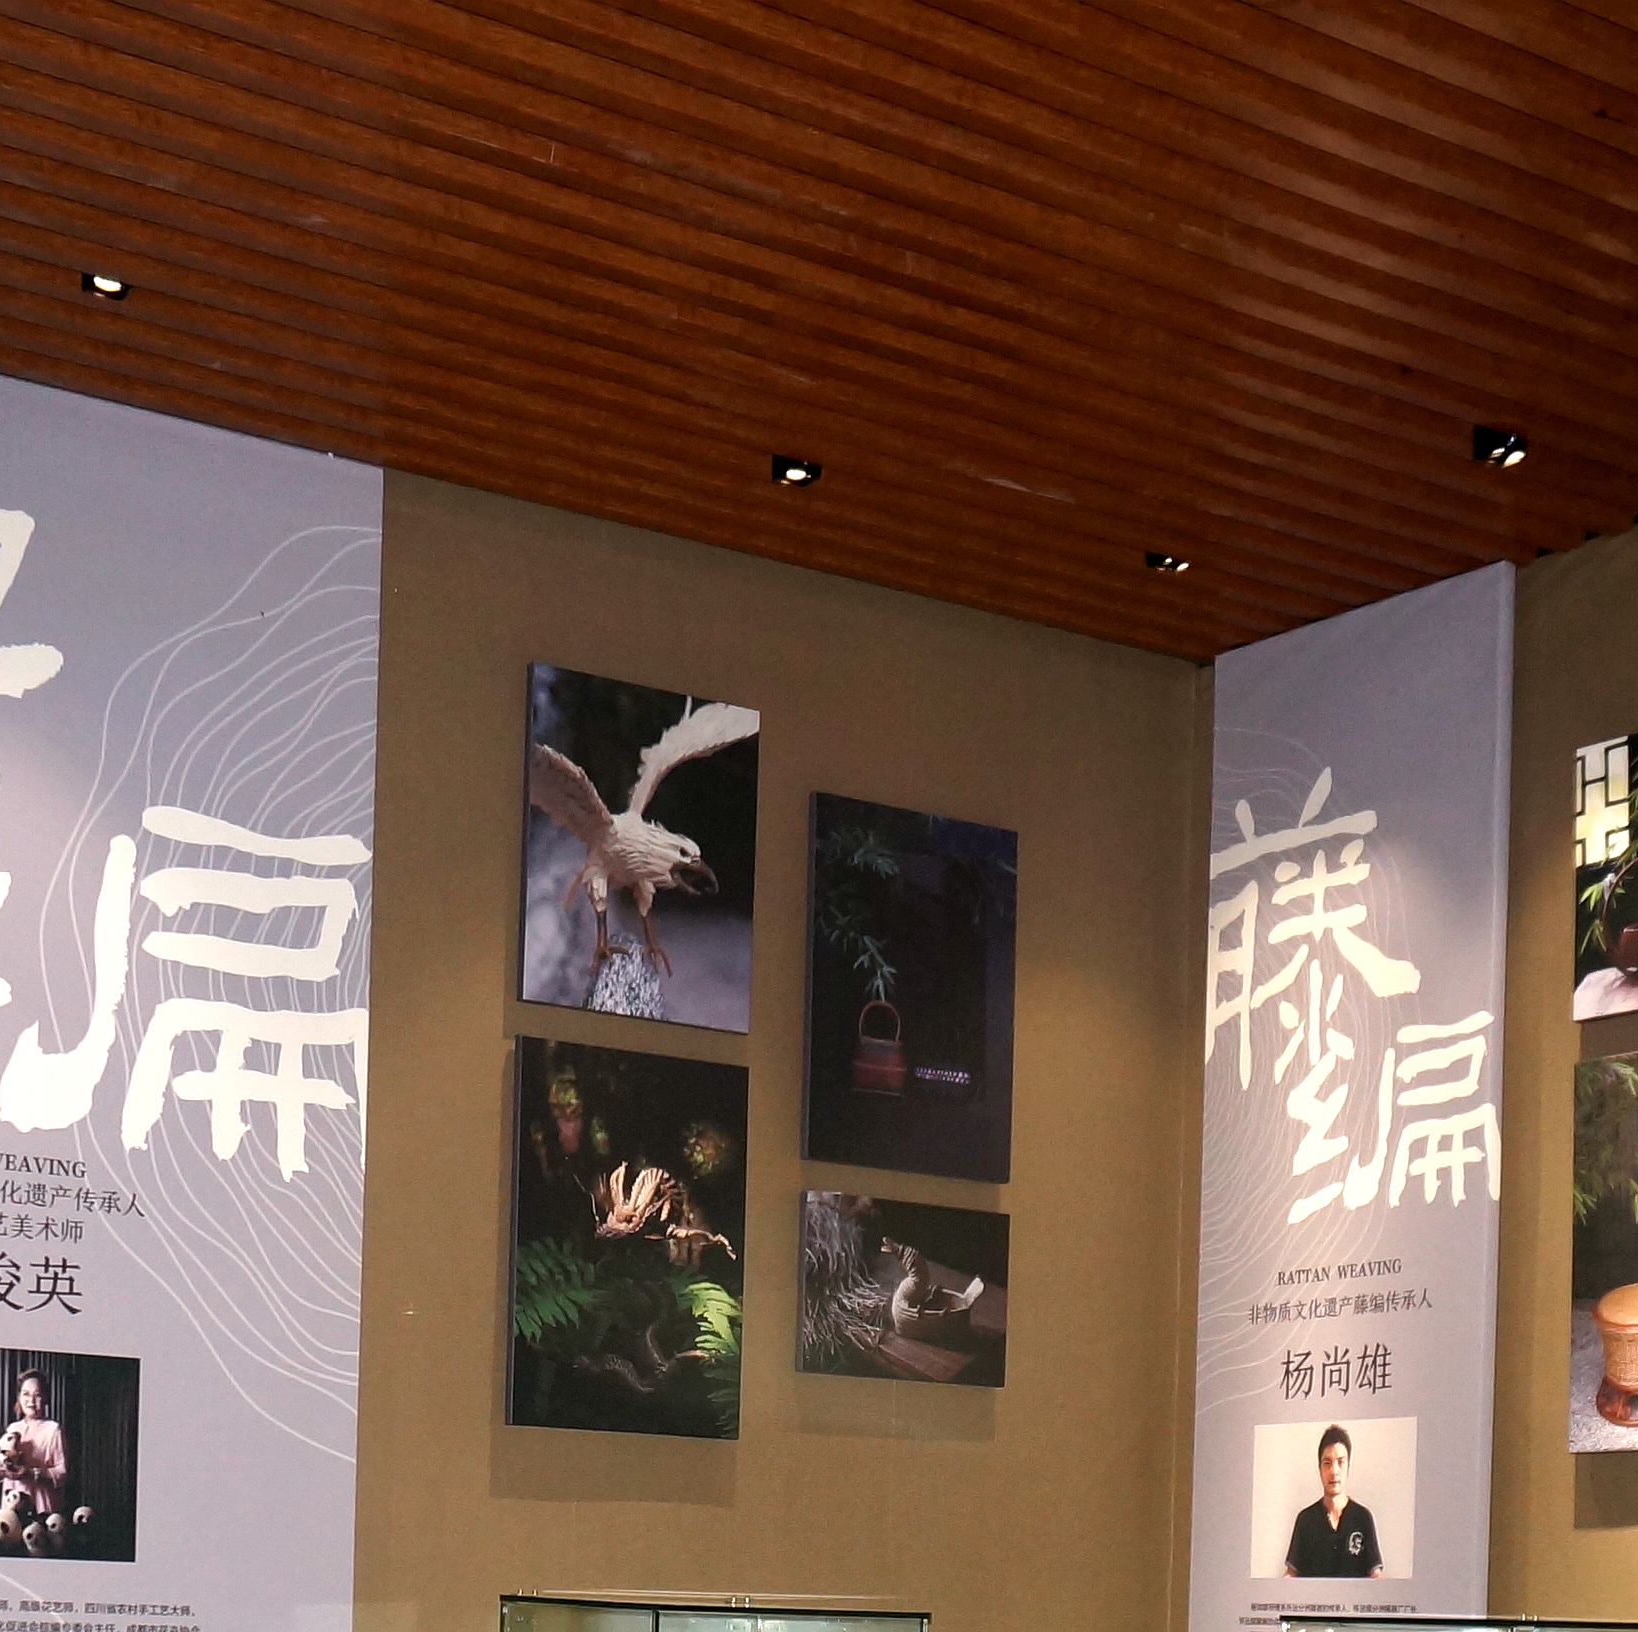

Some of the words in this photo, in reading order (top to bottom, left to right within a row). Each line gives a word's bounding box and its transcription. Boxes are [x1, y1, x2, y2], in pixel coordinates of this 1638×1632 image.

[1205, 766, 1503, 1225] 藤编
[1277, 1265, 1331, 1286] RATTAN
[1338, 1258, 1403, 1280] WEAVING
[1249, 1288, 1432, 1325] 非物质文化遗产藤编传承人
[1279, 1342, 1392, 1400] 杨尚雄
